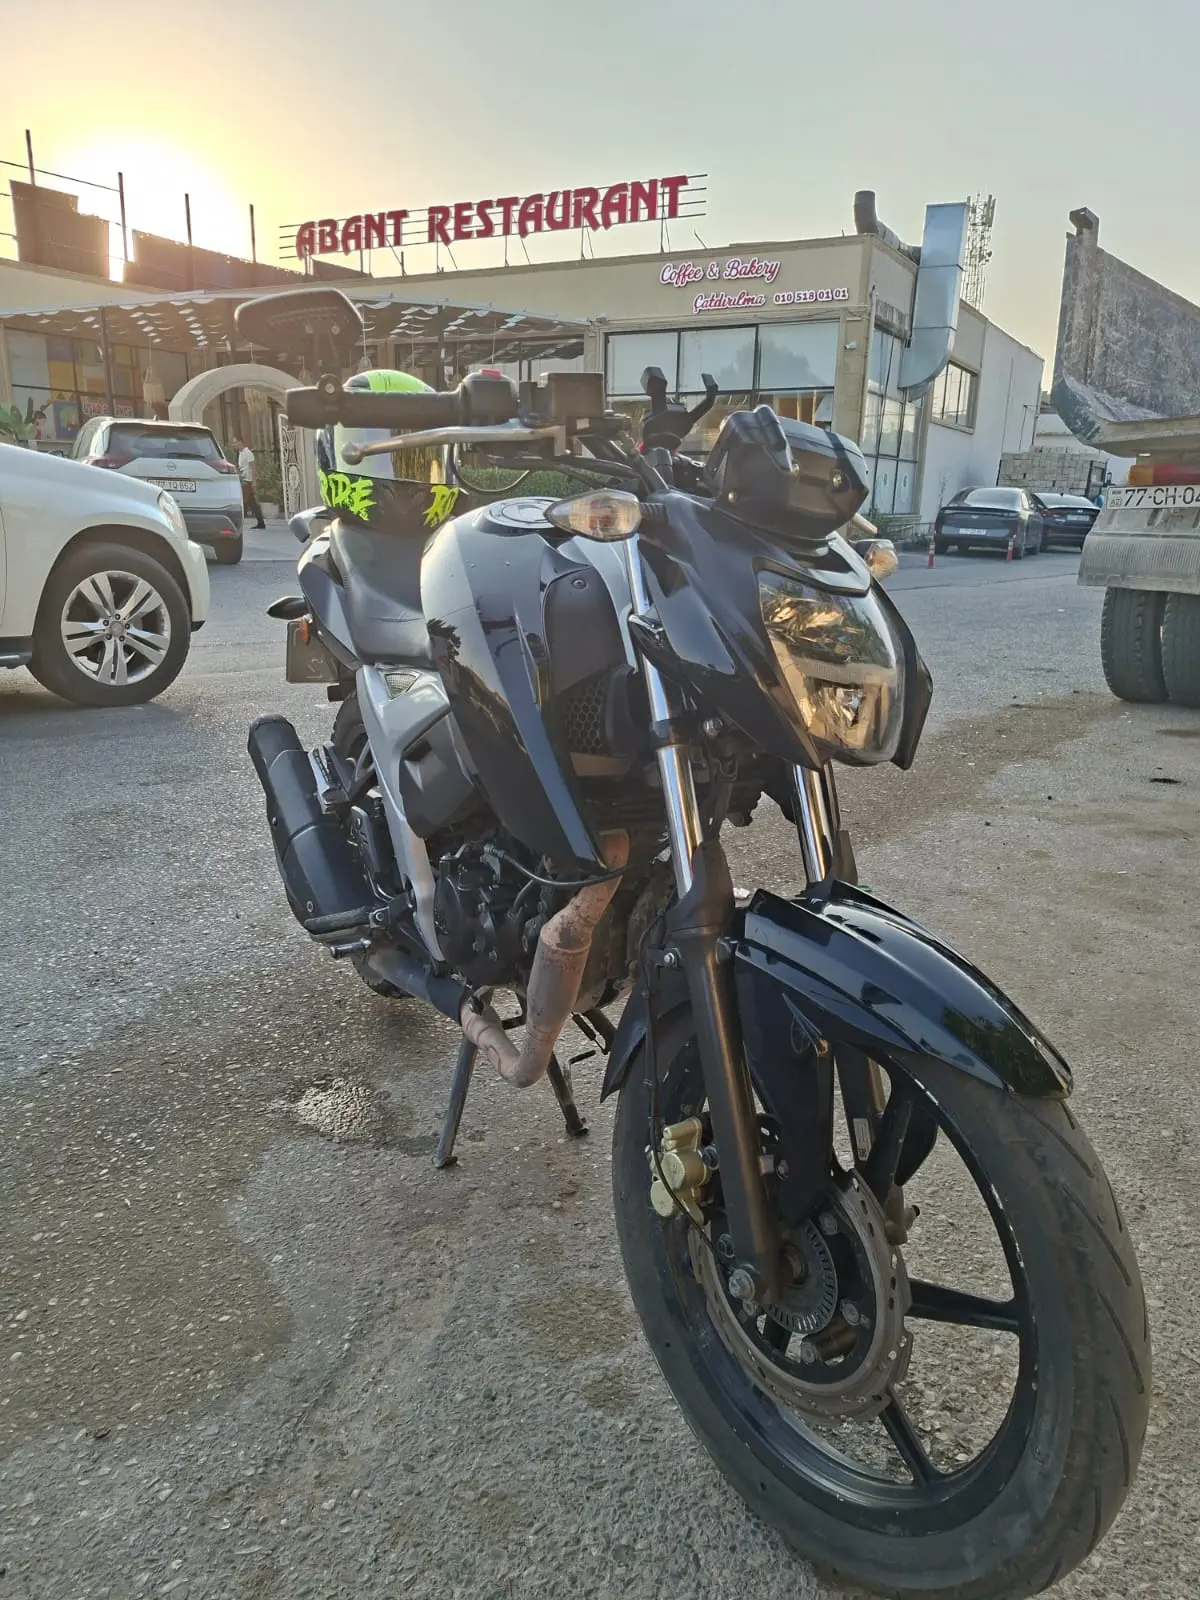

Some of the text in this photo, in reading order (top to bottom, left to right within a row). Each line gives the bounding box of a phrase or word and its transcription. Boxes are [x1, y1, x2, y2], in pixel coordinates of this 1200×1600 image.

[296, 175, 689, 260] ABANT RESTAURANT
[660, 258, 781, 287] Coffee & Bakery
[774, 293, 793, 304] 010
[795, 291, 815, 303] 518
[816, 290, 831, 301] 01
[834, 288, 849, 300] 01
